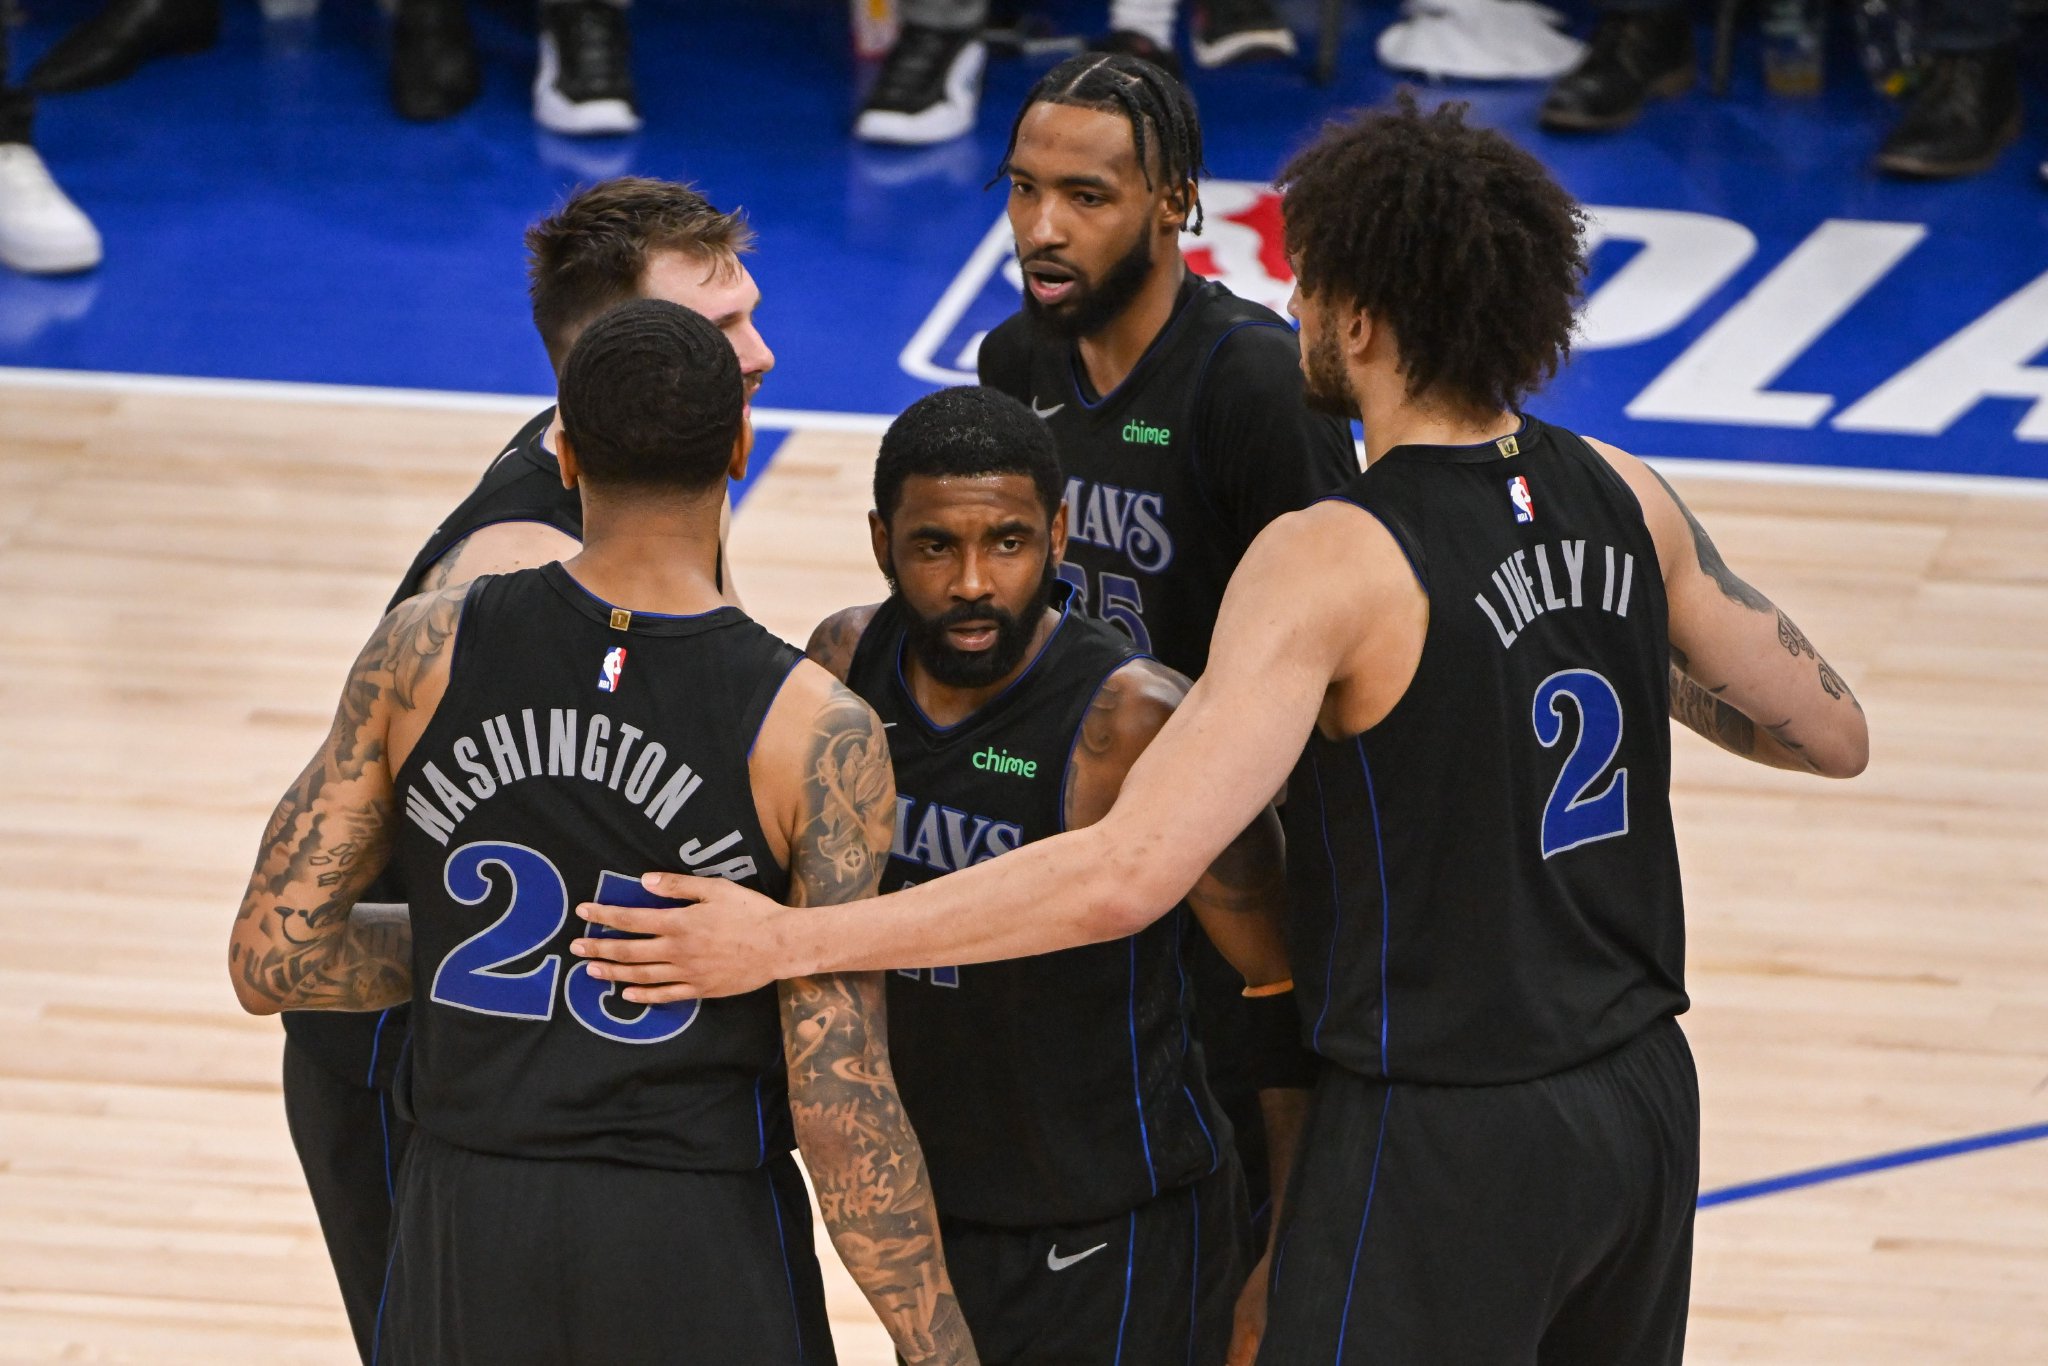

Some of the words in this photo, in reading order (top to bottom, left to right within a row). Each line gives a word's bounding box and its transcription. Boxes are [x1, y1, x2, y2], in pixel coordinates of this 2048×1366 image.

[1122, 419, 1170, 446] chime
[1057, 561, 1152, 654] 5
[1474, 539, 1586, 649] LIVELY
[1602, 545, 1635, 618] II
[405, 708, 704, 847] WASHINGTON
[972, 746, 1038, 778] chime
[1532, 668, 1629, 860] 2
